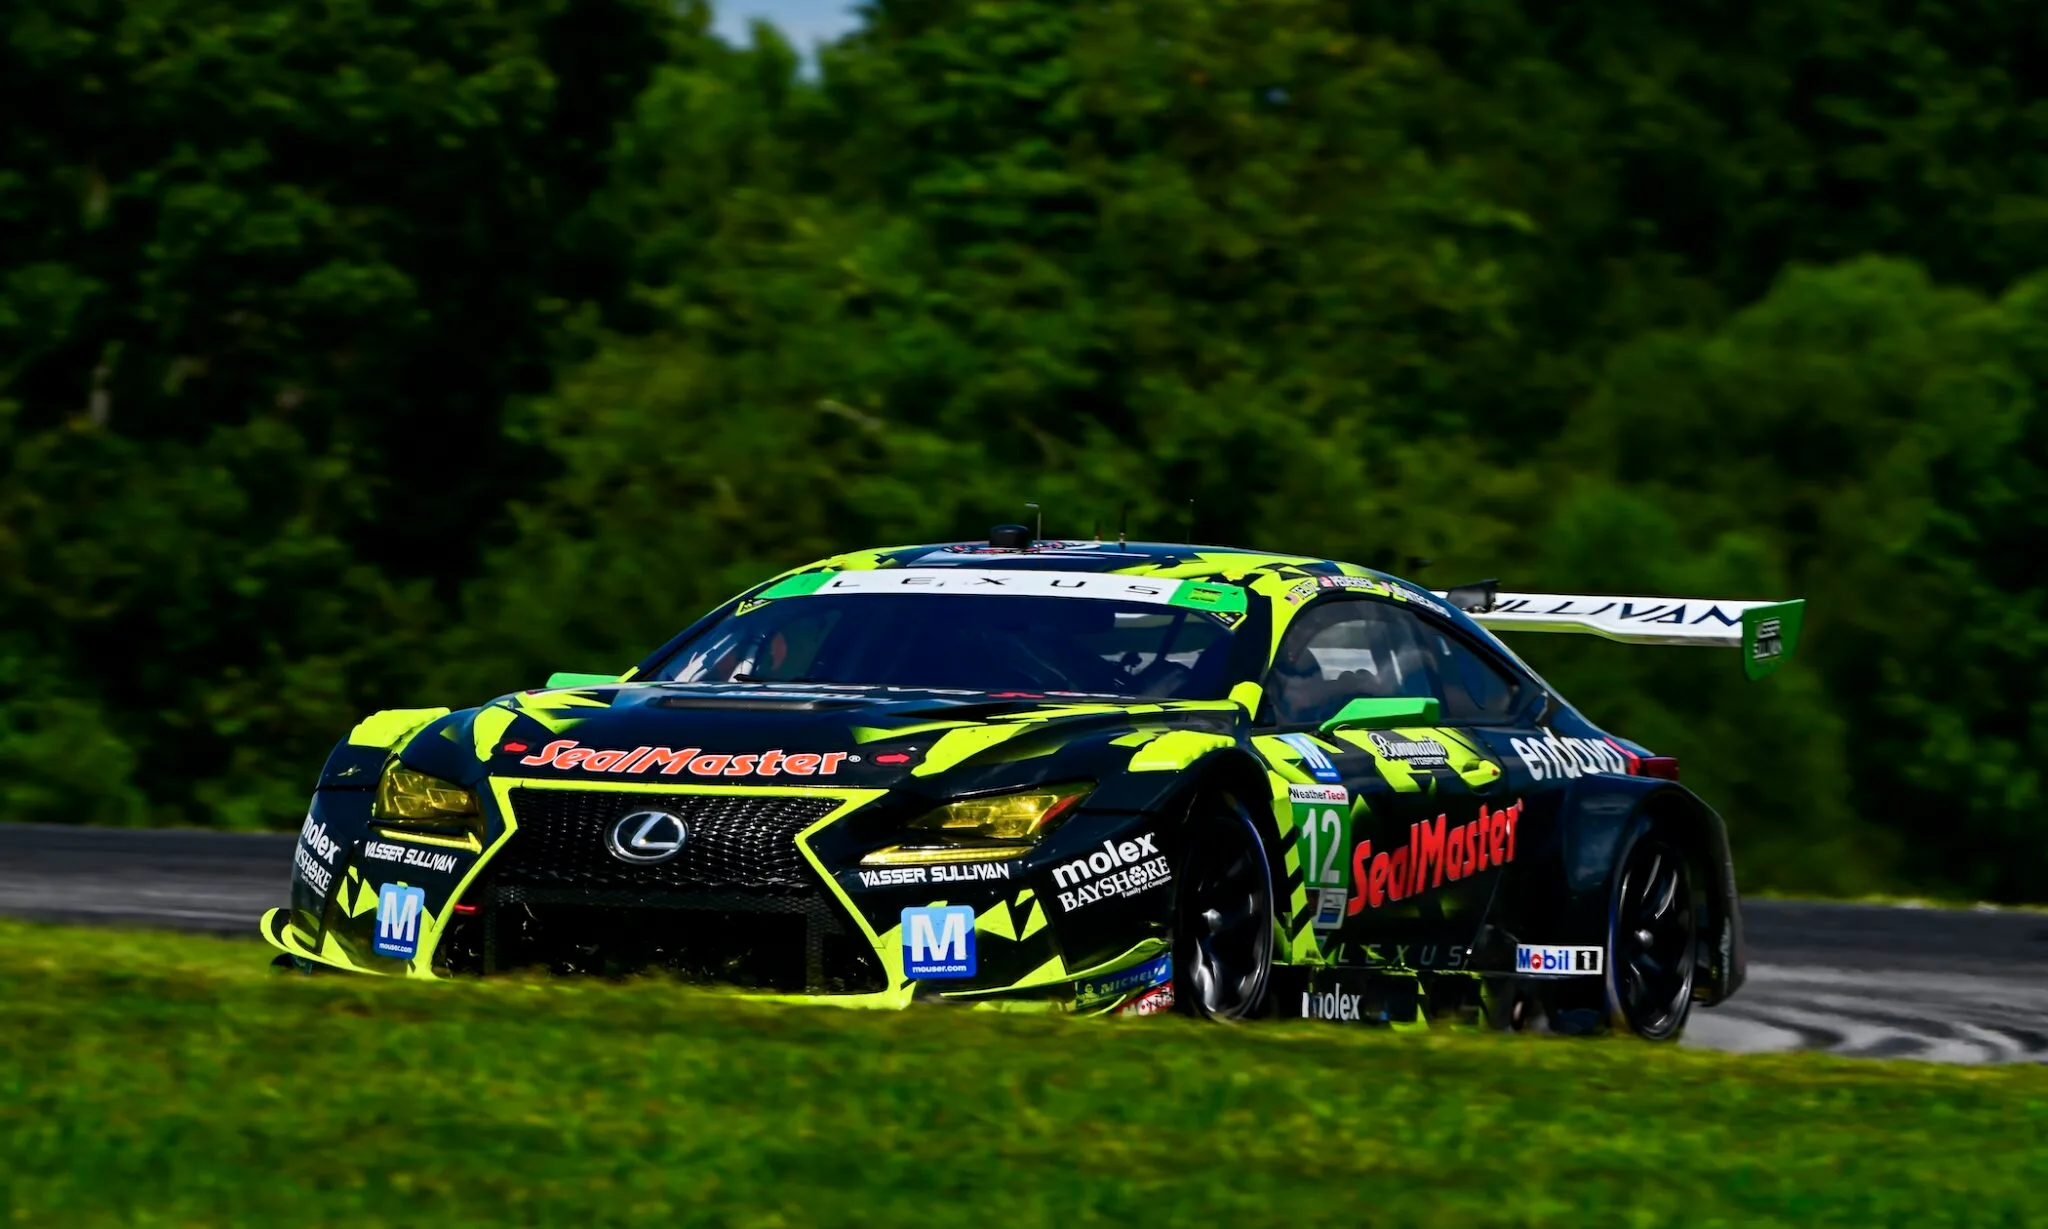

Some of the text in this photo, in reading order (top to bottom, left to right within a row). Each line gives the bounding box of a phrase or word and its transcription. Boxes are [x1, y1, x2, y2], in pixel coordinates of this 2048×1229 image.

[831, 577, 1164, 597] LEXUS
[1290, 788, 1345, 800] WeatherTech
[364, 841, 458, 874] VASSER SULLIVAN
[1051, 832, 1159, 889] molex
[1302, 807, 1342, 884] 12
[1347, 802, 1519, 917] SealMaster
[859, 862, 1010, 888] VASSER SULLIVAN
[1057, 855, 1171, 912] BAYSHORE
[379, 891, 419, 943] M
[910, 912, 967, 962] M
[912, 964, 967, 974] mouser.com
[1338, 942, 1462, 967] LEXUS
[1518, 948, 1569, 971] Mobil
